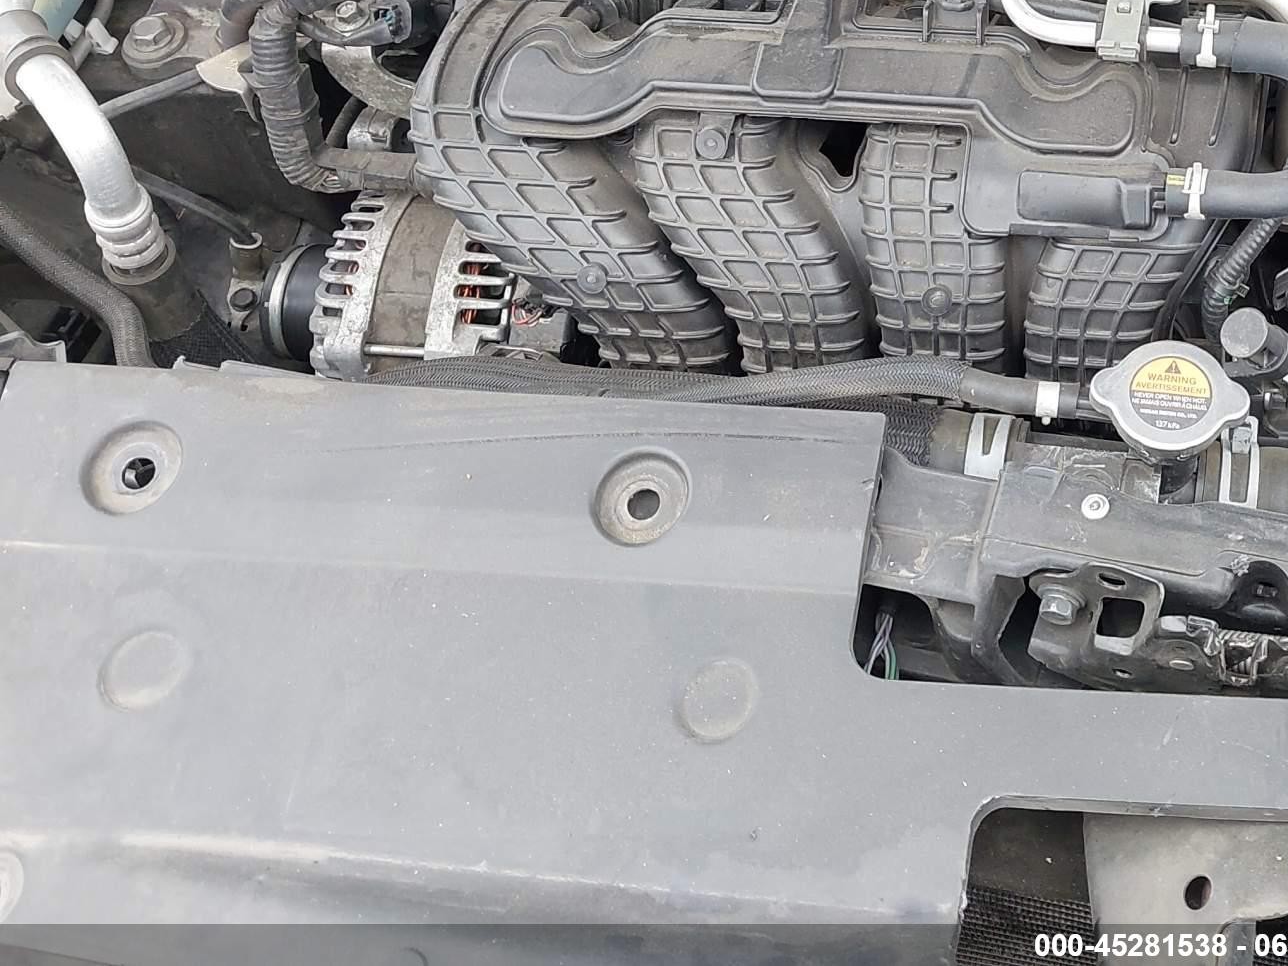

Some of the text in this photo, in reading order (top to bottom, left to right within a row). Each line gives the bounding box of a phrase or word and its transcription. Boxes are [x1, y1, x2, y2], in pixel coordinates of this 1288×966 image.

[1147, 373, 1196, 385] WARNING
[1136, 381, 1206, 394] AVERTISSEMENT
[1155, 393, 1172, 401] OPEN
[1173, 394, 1192, 402] WHEN
